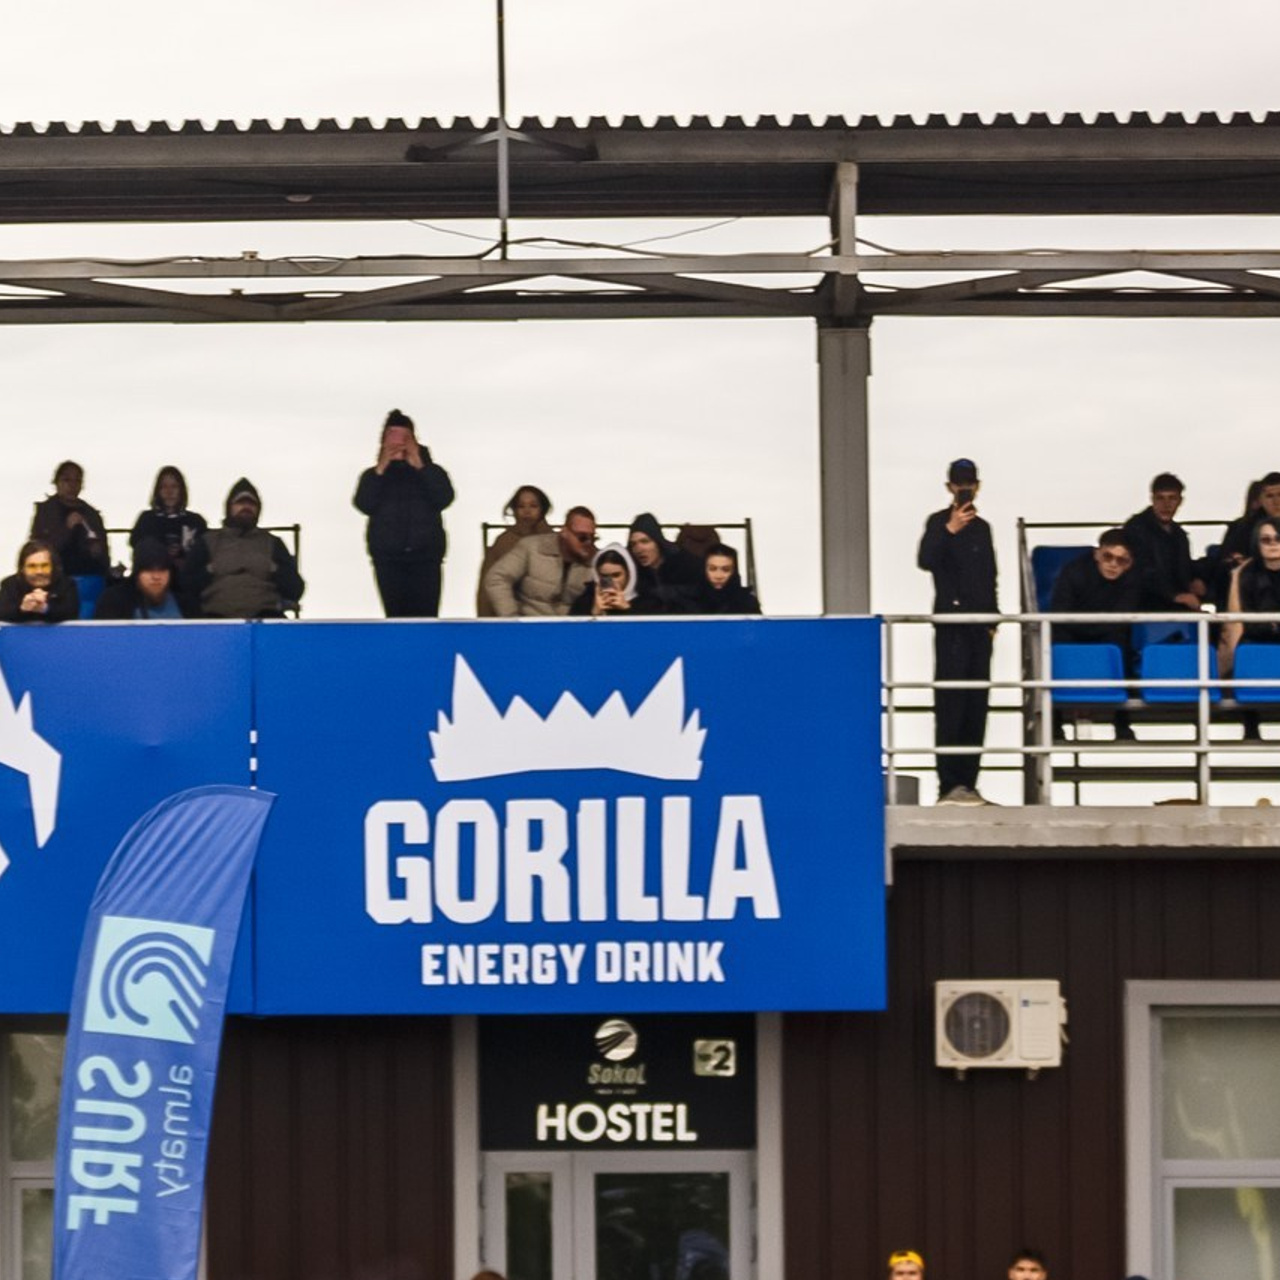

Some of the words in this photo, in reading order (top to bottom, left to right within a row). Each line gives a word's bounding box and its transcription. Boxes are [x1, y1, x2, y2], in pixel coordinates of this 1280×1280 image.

[364, 795, 781, 925] GORILLA
[421, 943, 586, 986] ENERGY
[595, 941, 725, 984] DRINK
[536, 1102, 698, 1142] HOSTEL
